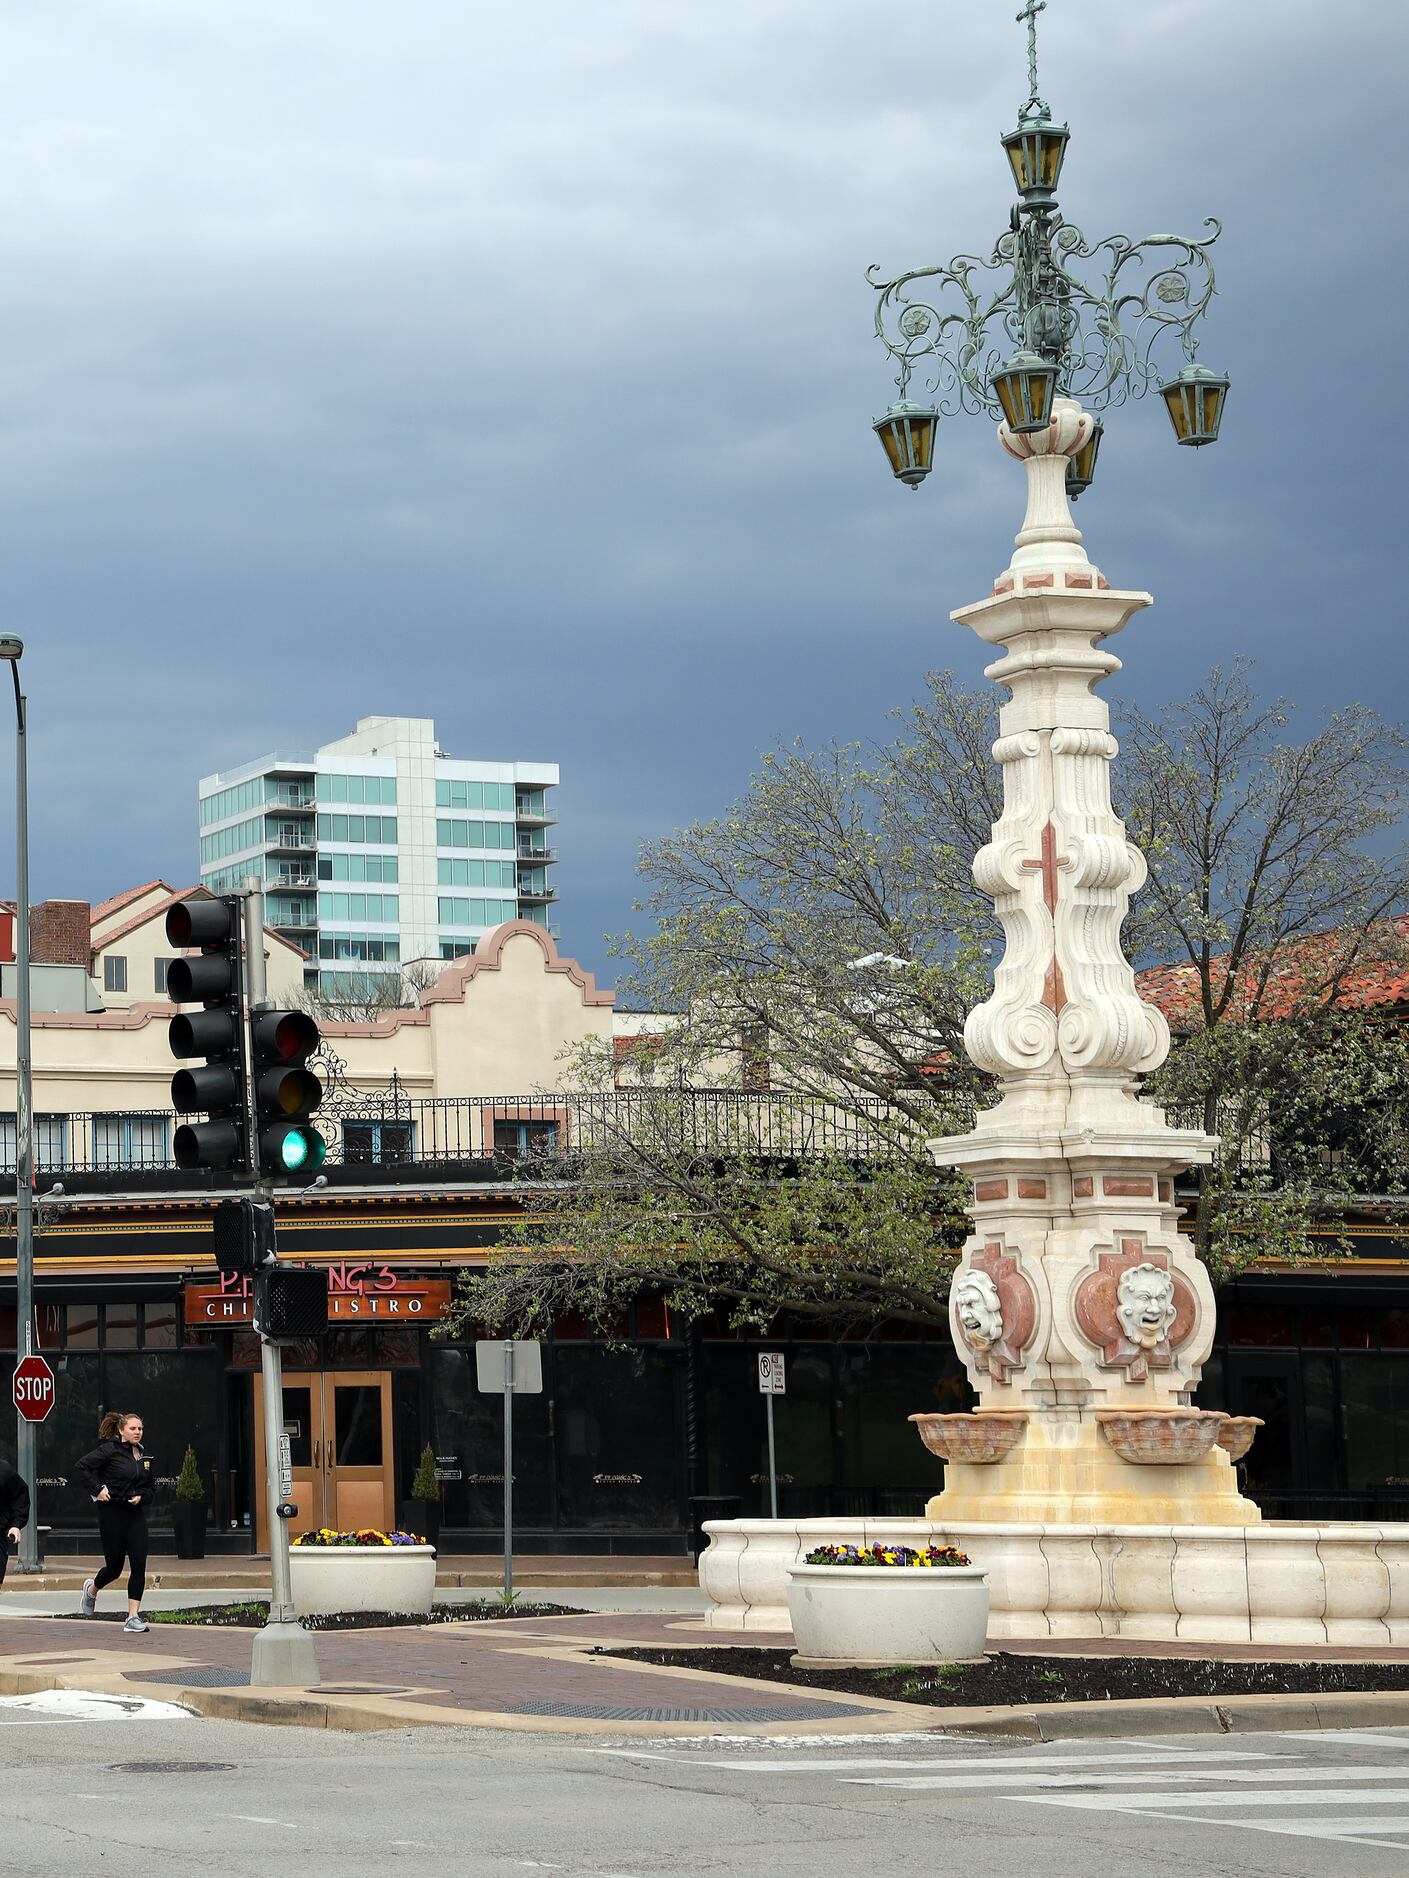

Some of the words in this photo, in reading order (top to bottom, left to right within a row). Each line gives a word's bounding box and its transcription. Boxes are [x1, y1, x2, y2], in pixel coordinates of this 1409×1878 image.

[206, 1301, 248, 1316] CHI
[334, 1299, 423, 1314] ISTRO
[16, 1377, 52, 1401] STOP
